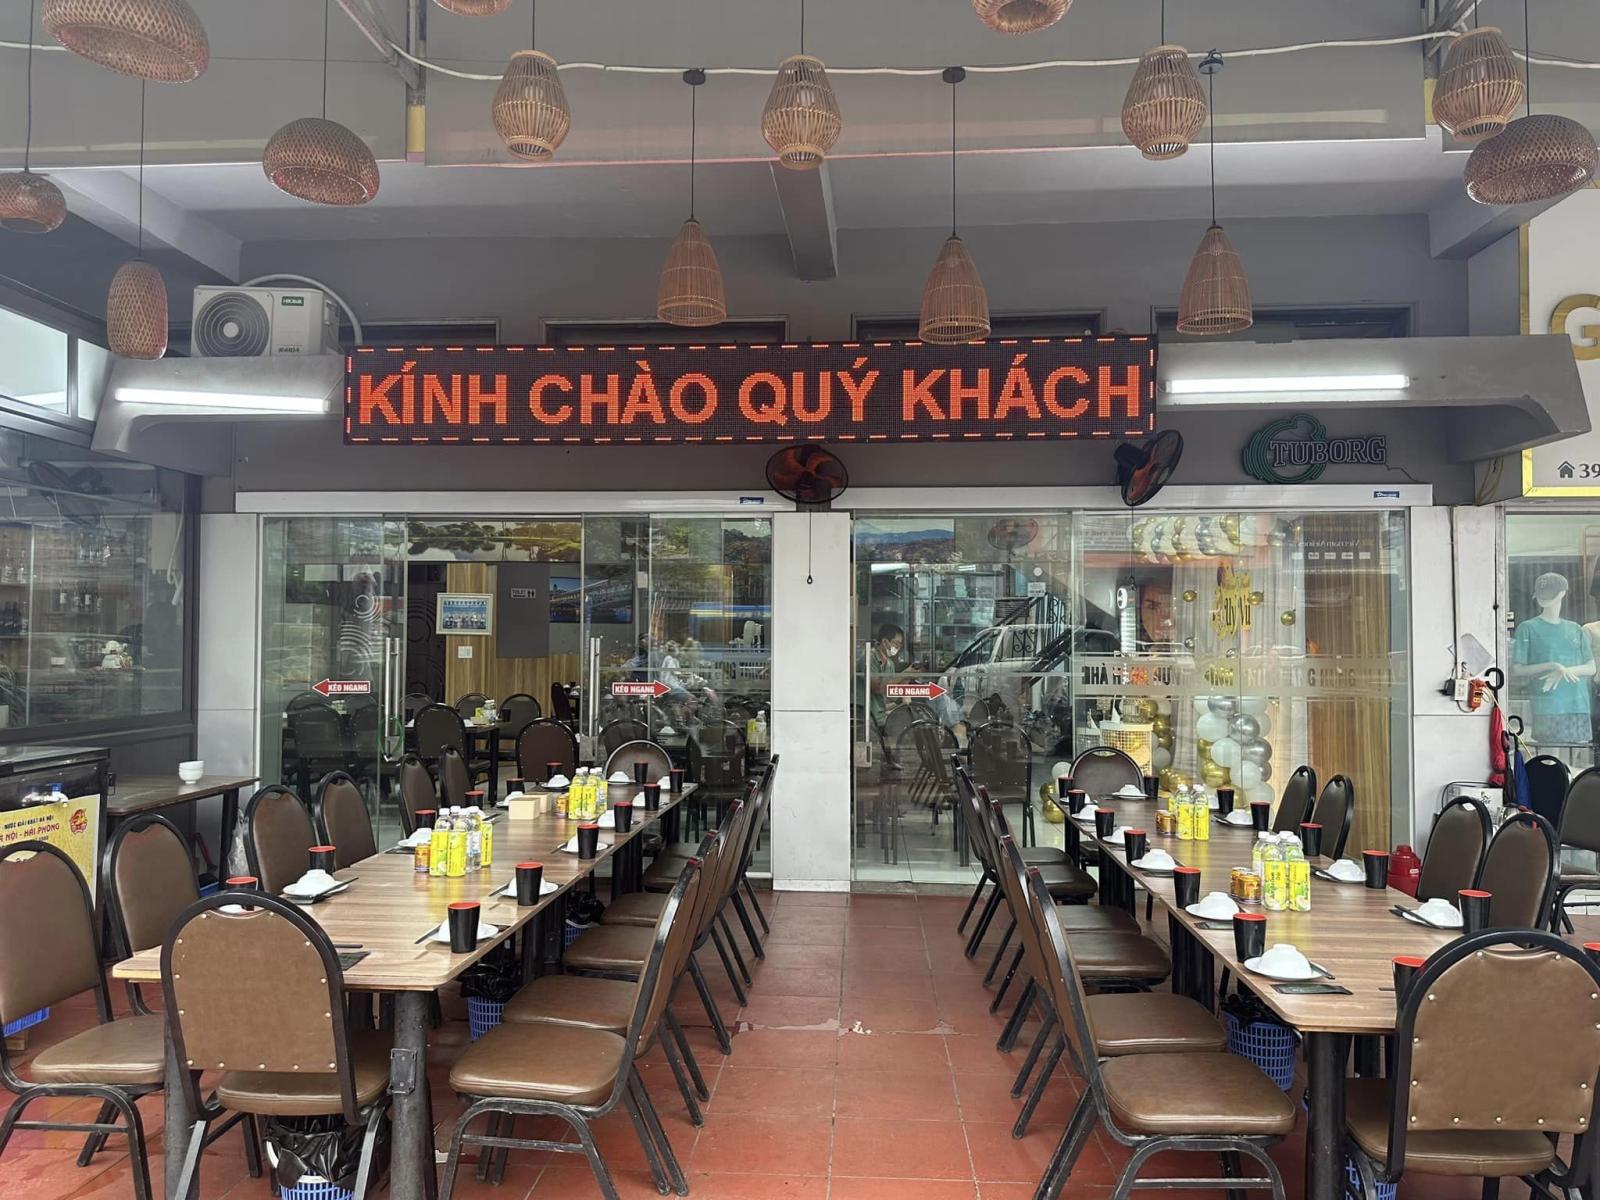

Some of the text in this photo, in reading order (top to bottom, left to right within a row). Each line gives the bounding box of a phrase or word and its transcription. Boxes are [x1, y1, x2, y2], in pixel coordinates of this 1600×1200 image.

[359, 353, 1140, 426] KÍNH CHÀO QUÝ KHÁCH
[1270, 435, 1387, 467] TUBORG
[328, 683, 342, 691] KÉO
[615, 685, 629, 693] KÉO
[889, 687, 904, 695] KÉO
